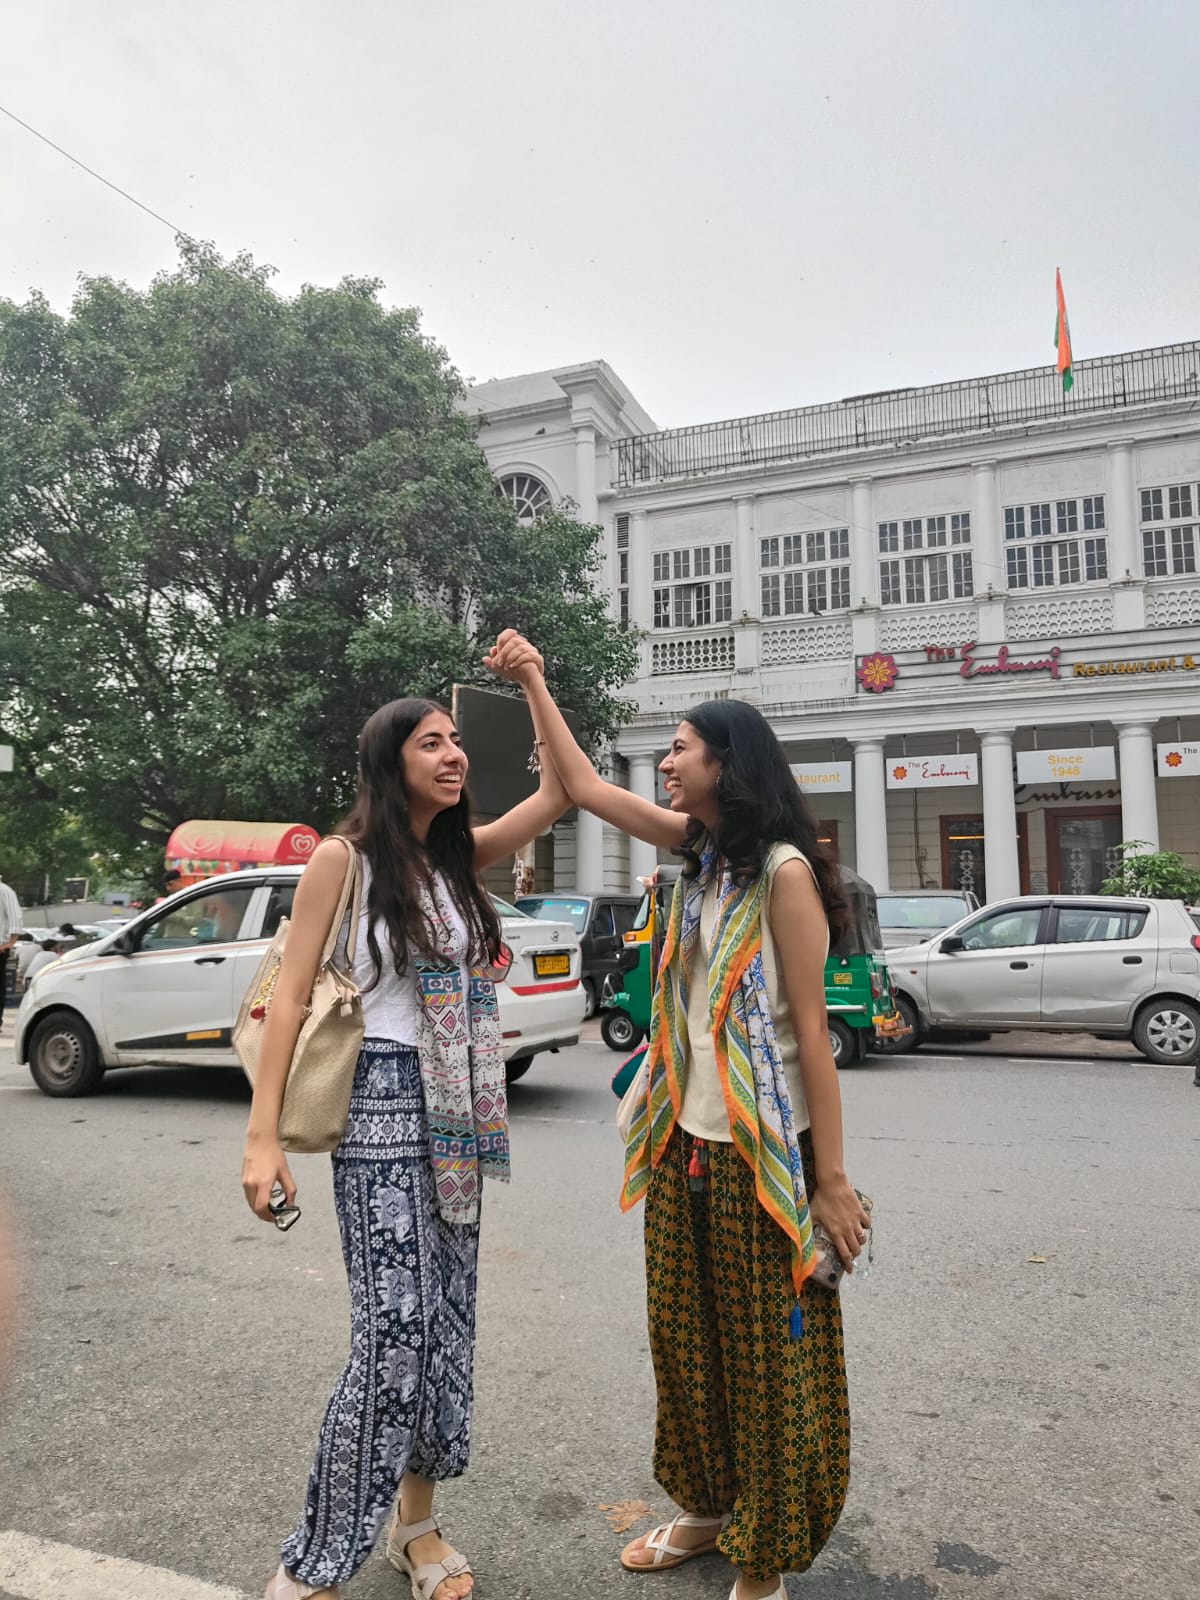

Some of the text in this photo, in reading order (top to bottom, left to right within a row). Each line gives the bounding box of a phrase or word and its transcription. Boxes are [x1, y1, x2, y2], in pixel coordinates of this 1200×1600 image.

[924, 640, 1195, 680] The Embassy Restaurant &
[1048, 755, 1083, 765] Since
[1052, 767, 1081, 777] 1948
